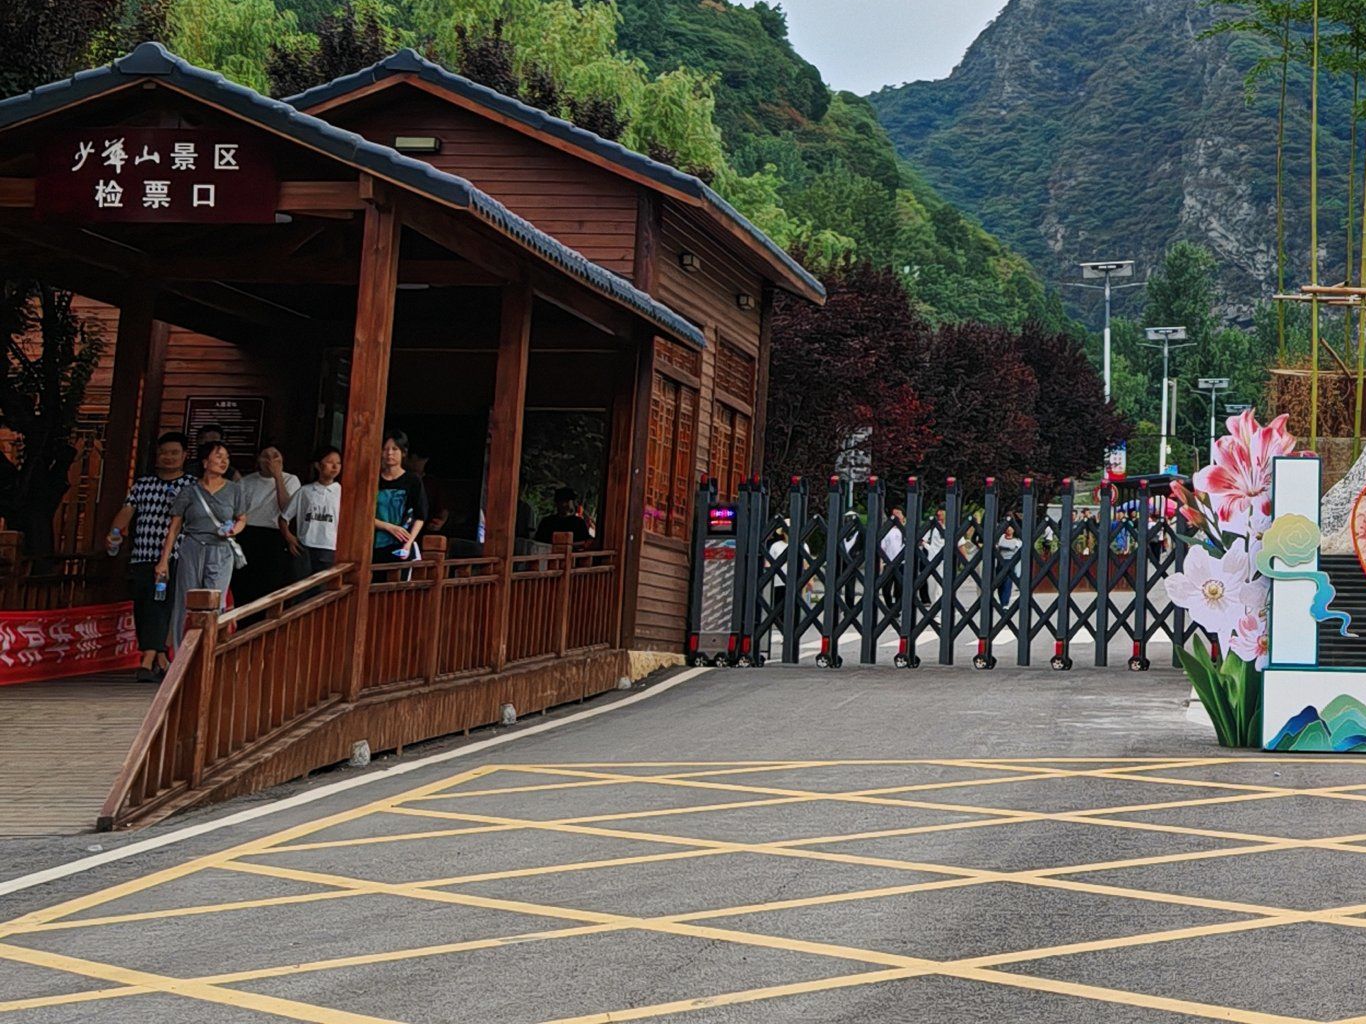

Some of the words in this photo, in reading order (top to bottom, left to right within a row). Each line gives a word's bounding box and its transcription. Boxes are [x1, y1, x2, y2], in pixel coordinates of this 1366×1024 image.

[94, 179, 216, 209] 检票口
[1269, 457, 1321, 667] I
